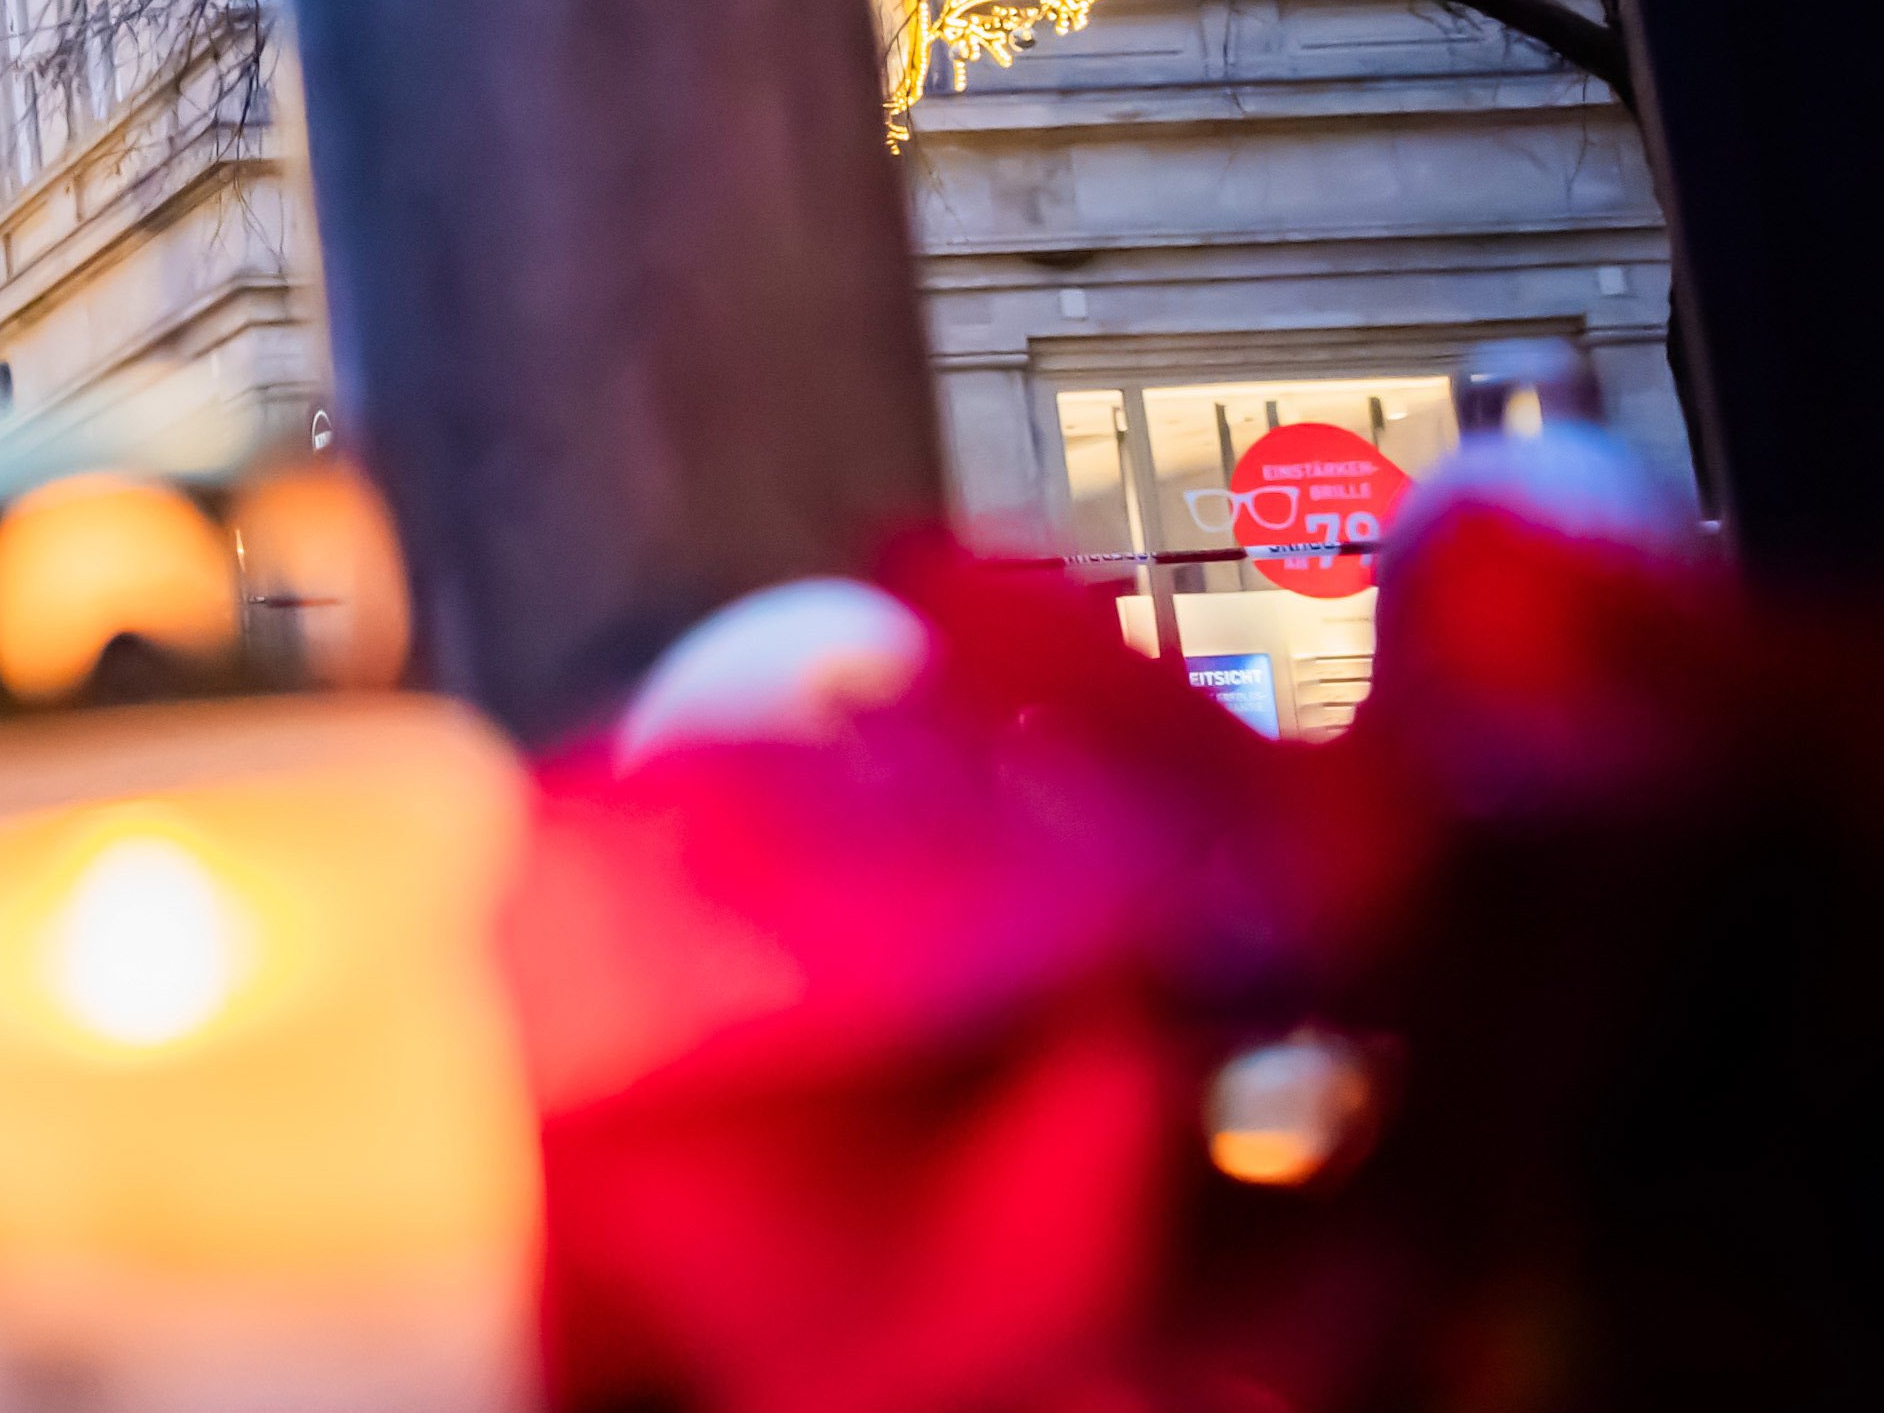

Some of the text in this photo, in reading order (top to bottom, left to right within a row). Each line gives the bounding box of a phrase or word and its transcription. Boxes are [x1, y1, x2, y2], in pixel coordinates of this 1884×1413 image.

[1309, 483, 1372, 501] BRILLE
[1304, 511, 1381, 570] 79
[1189, 670, 1263, 687] EITSICHT
